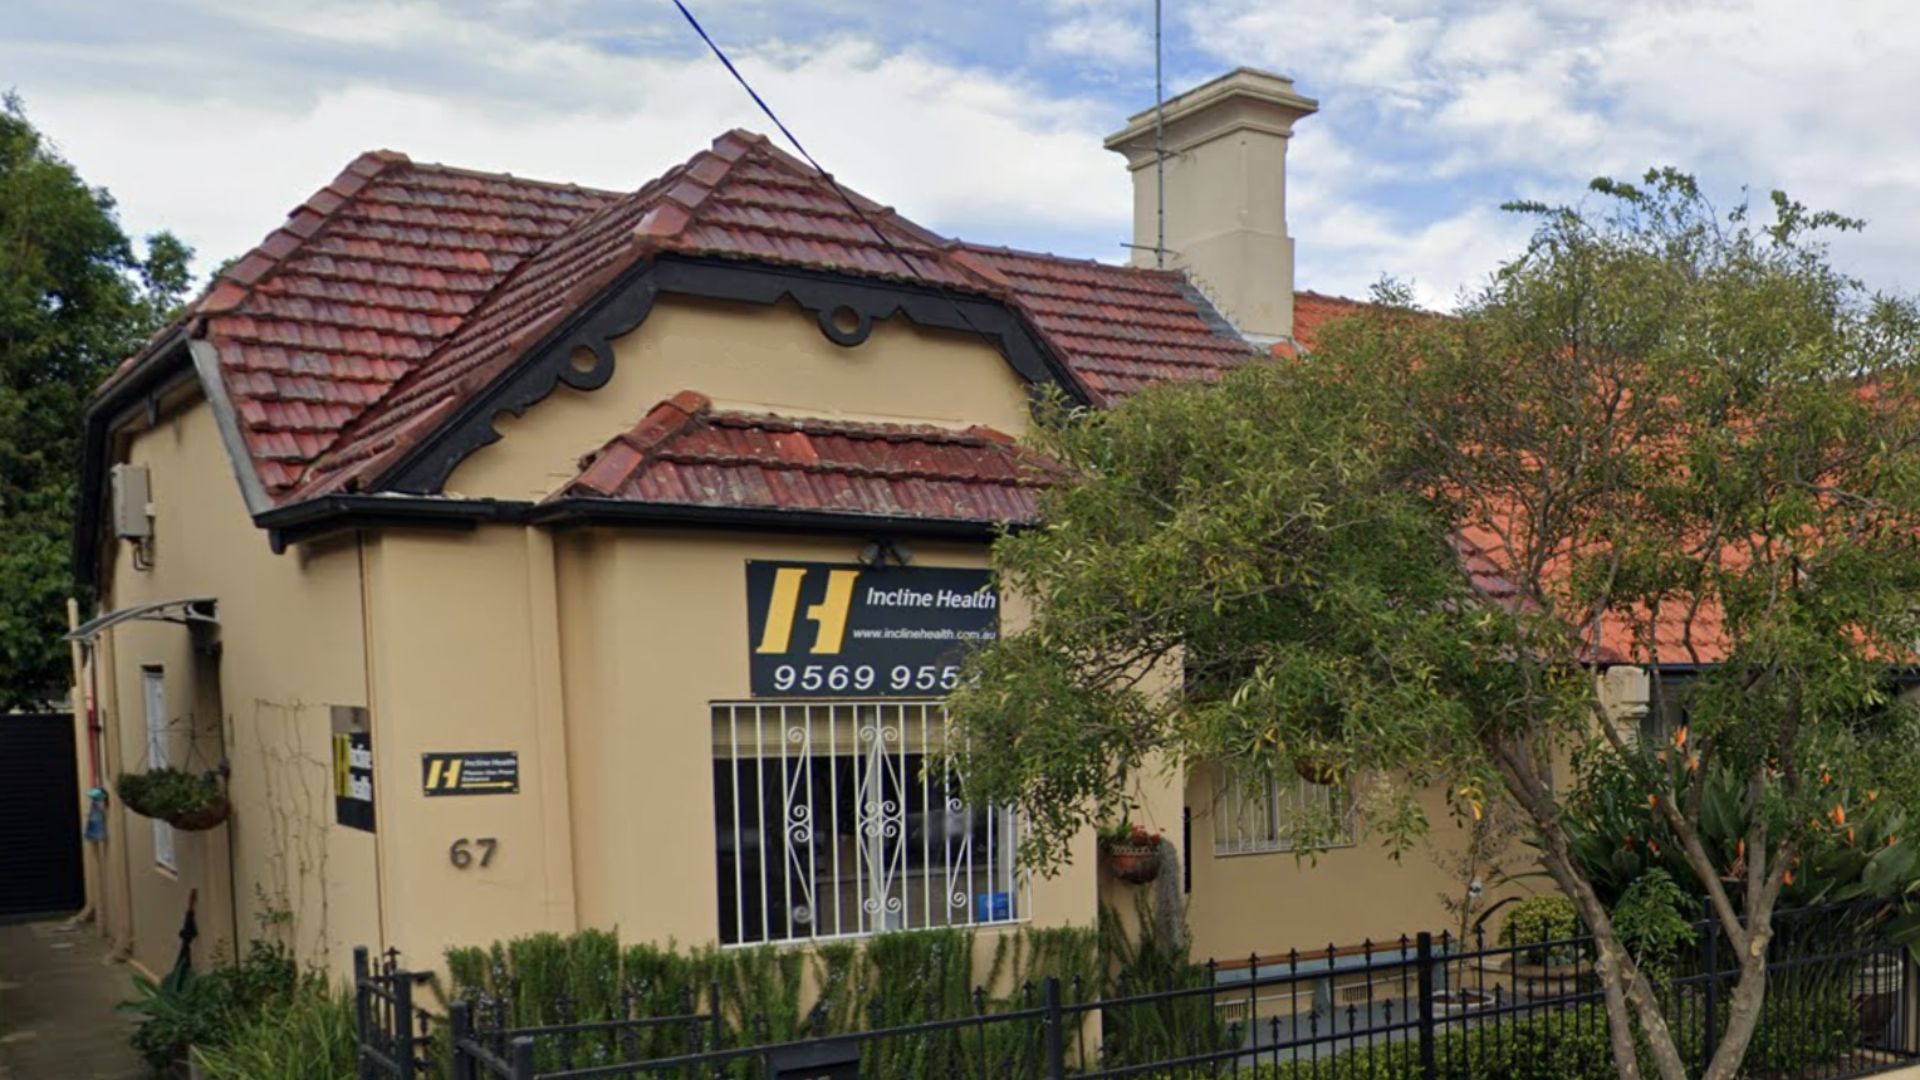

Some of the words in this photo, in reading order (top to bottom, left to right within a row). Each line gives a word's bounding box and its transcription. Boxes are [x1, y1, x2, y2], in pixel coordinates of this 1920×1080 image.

[866, 586, 933, 607] Incline
[935, 589, 996, 609] Health
[852, 627, 996, 640] www.inclinehealth.com.au
[773, 664, 875, 691] 9569
[890, 664, 983, 691] 955
[449, 837, 498, 869] 67
